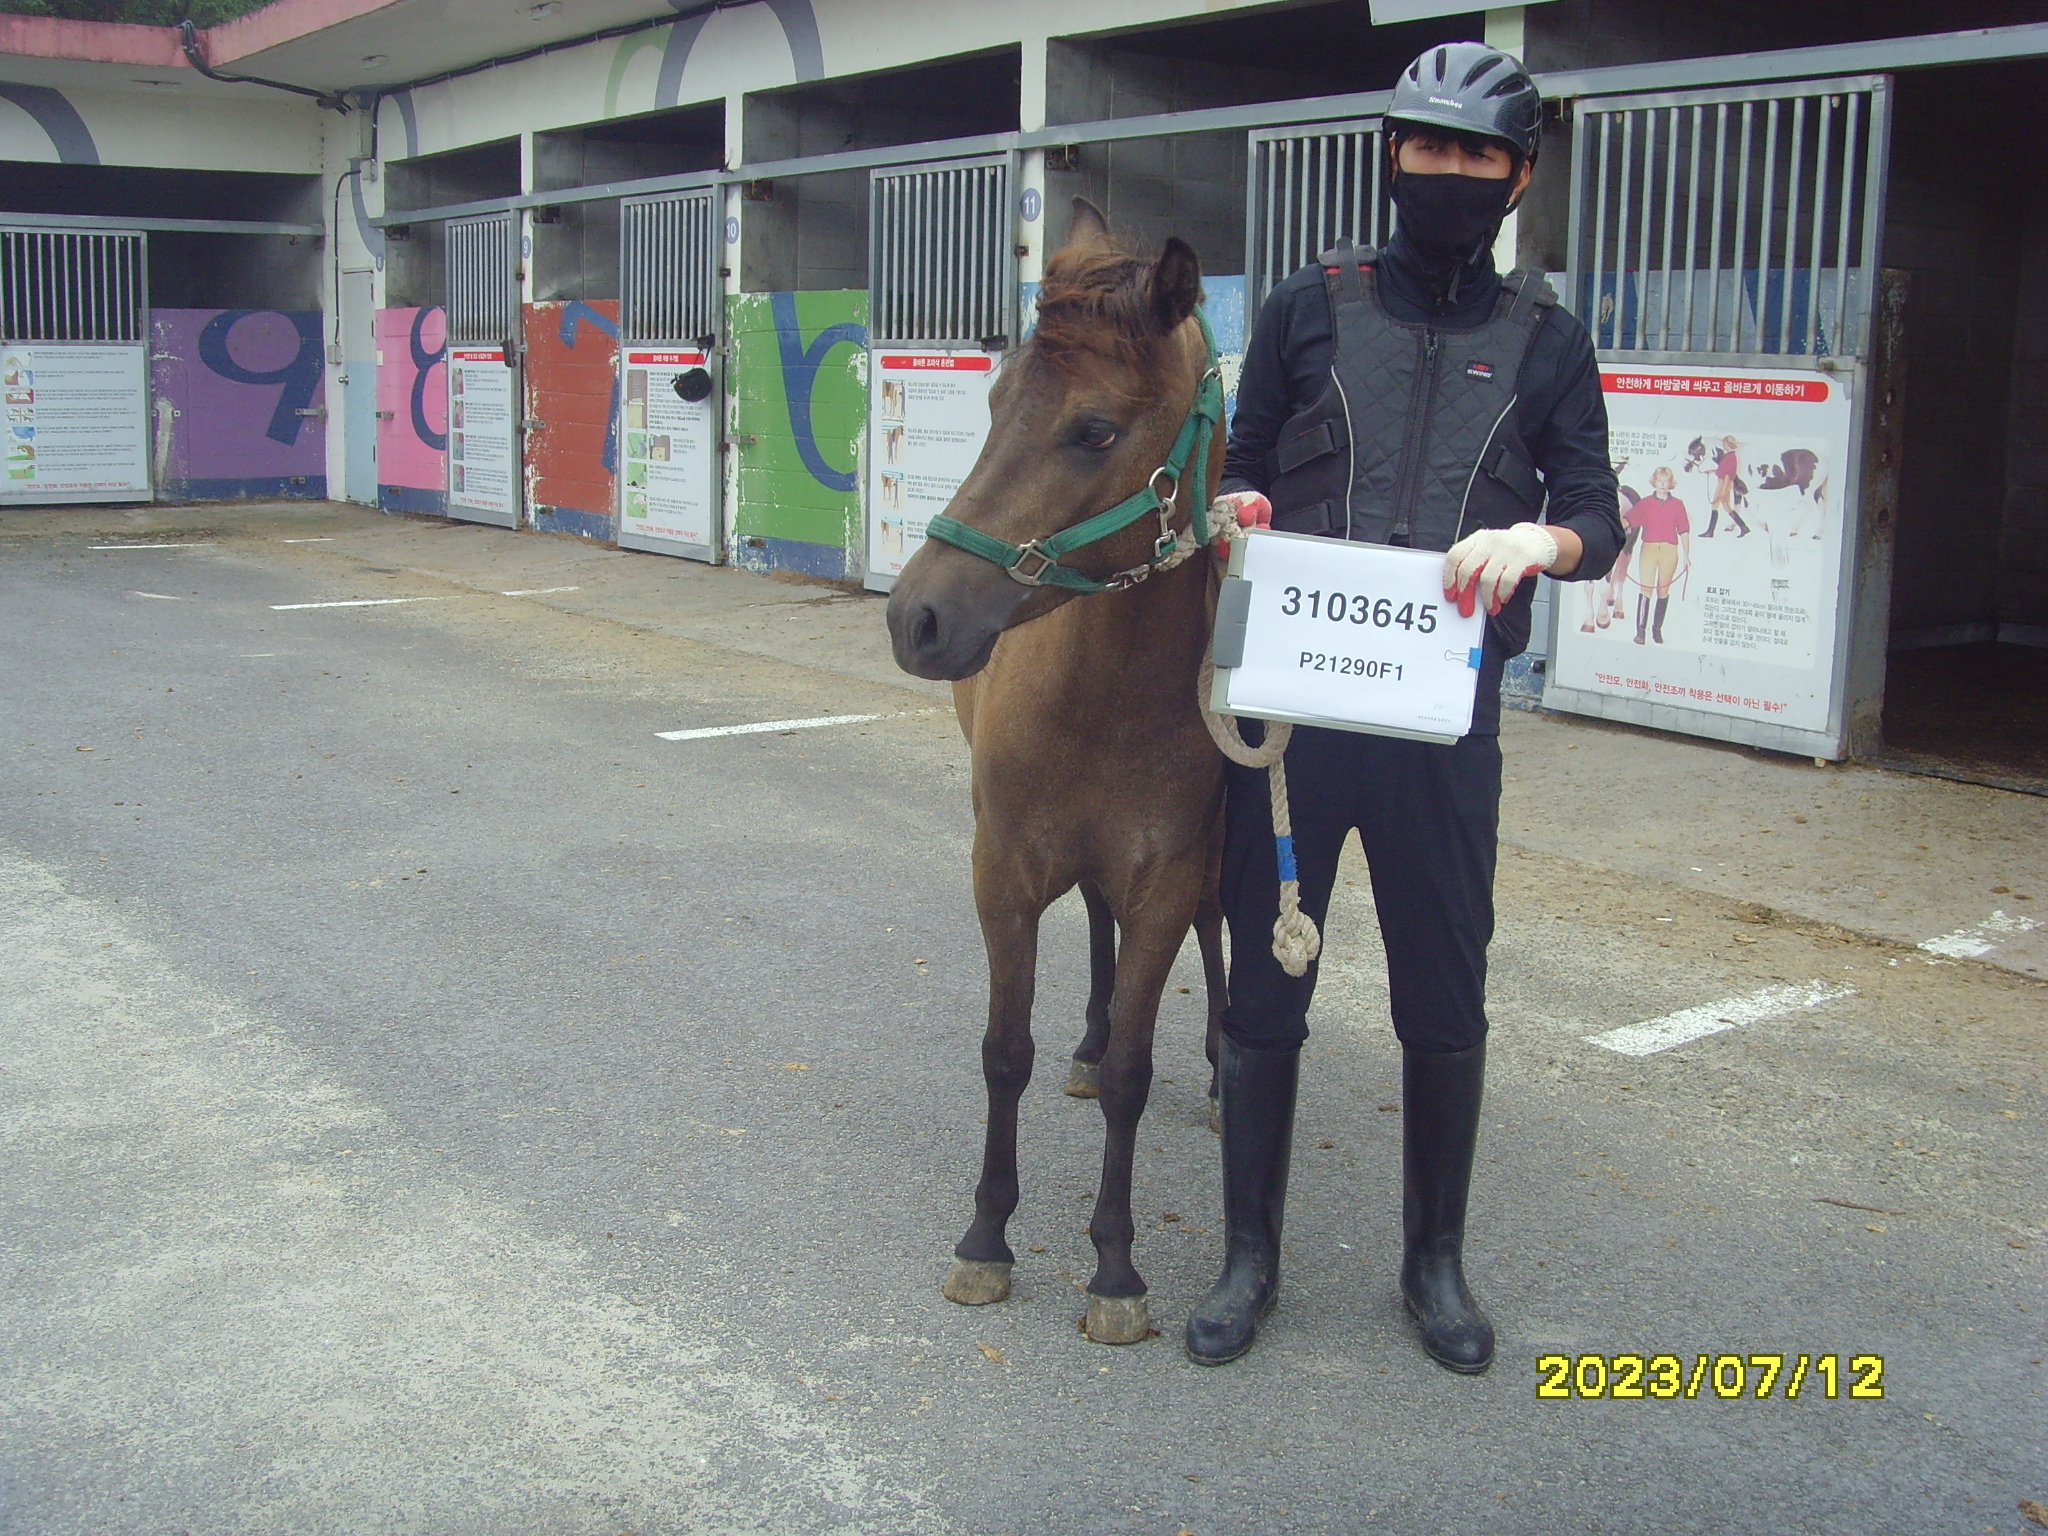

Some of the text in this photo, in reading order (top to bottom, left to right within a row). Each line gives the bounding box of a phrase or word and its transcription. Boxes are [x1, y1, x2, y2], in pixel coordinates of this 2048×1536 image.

[1024, 195, 1036, 215] 11
[726, 222, 737, 239] 10
[523, 240, 530, 254] 9
[198, 309, 325, 447] 9
[1616, 378, 1804, 396] 안전하게 마방굴레 씌우고 올바르게 이동하기
[1282, 586, 1438, 634] 3103645
[1300, 652, 1404, 680] P21290F1
[1626, 677, 1651, 691] 안전화,
[1655, 682, 1686, 697] 안전조끼
[1689, 688, 1712, 701] 착용은
[1716, 693, 1740, 705] 선택이
[1743, 697, 1759, 709] 아닌
